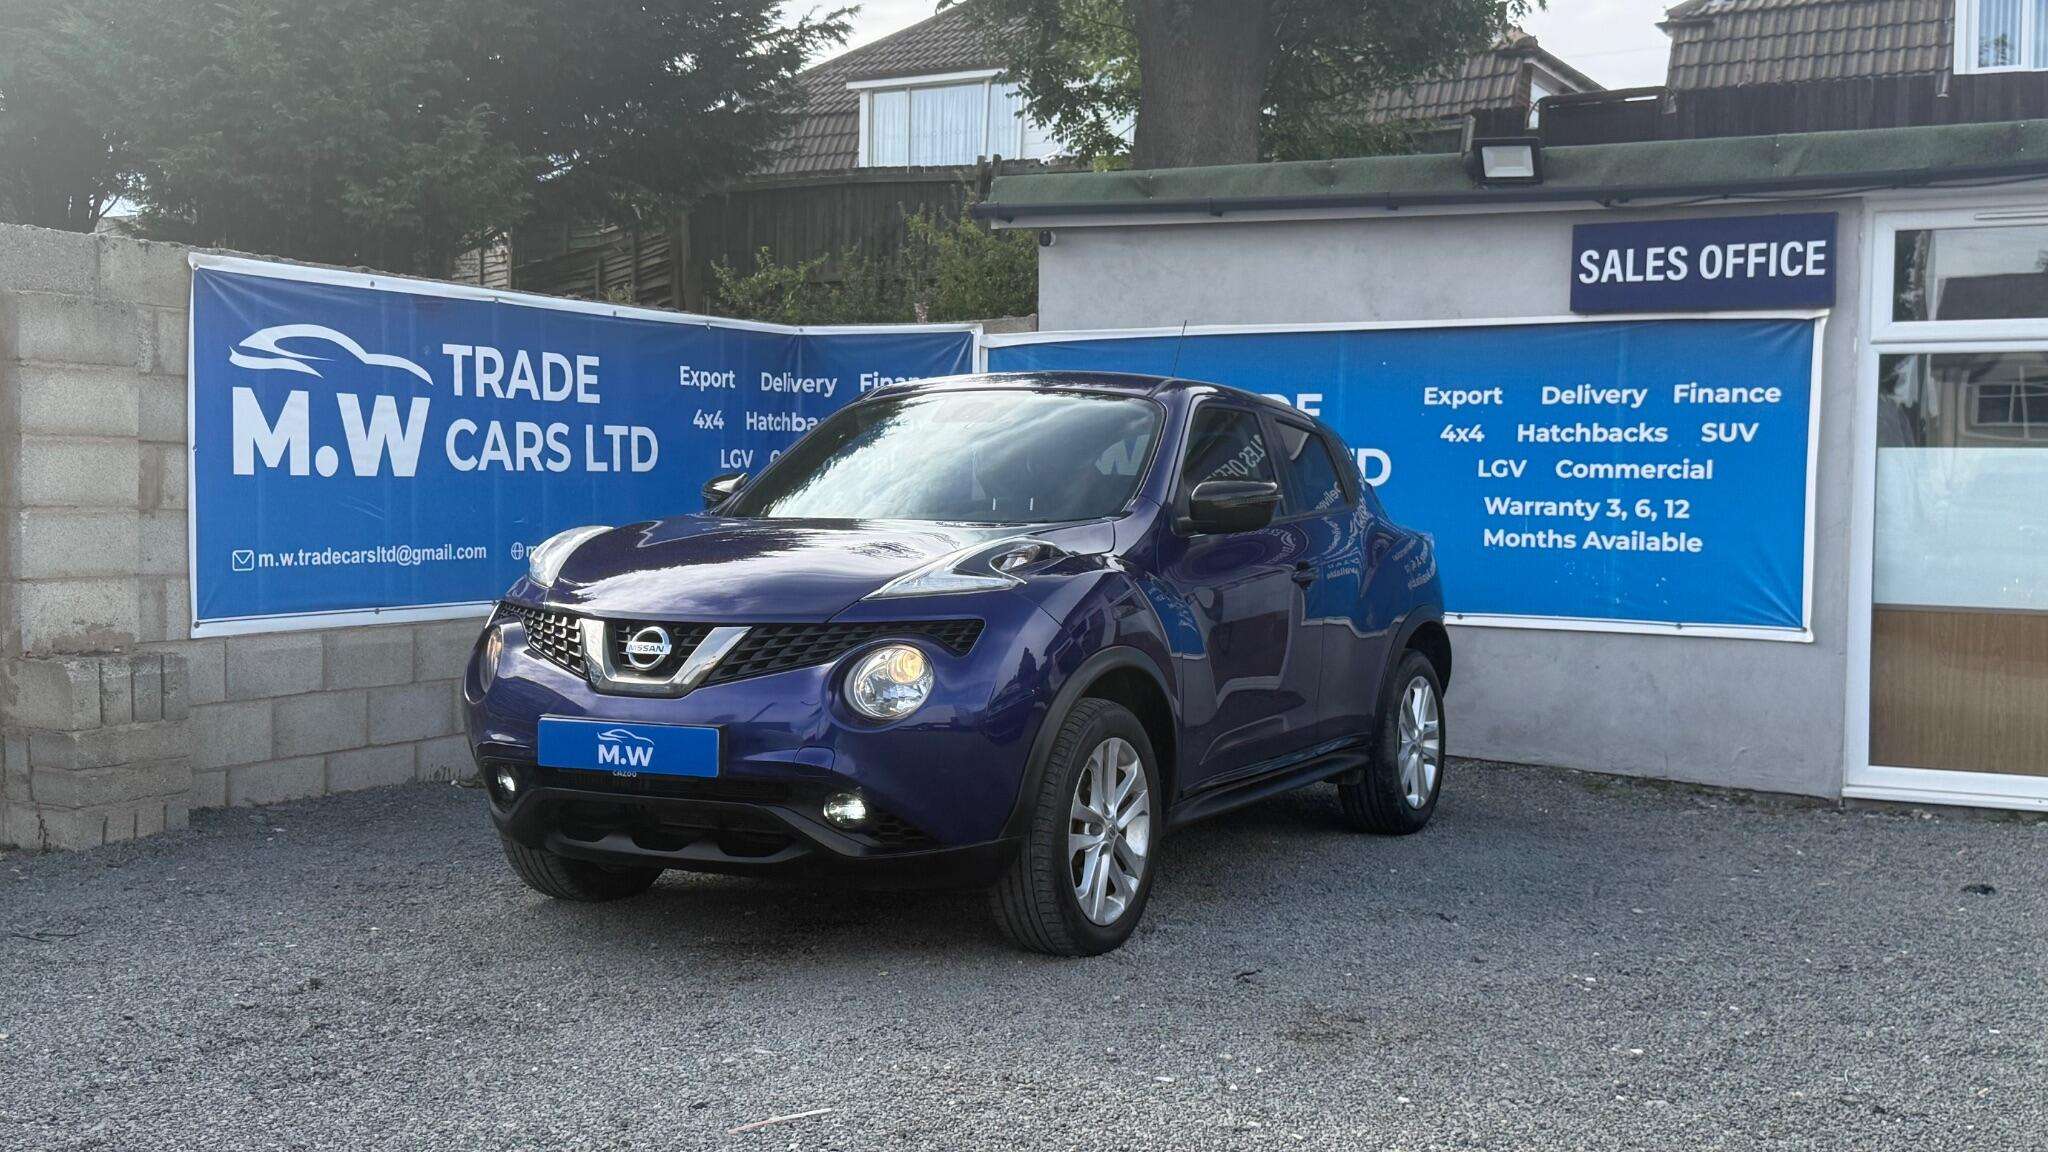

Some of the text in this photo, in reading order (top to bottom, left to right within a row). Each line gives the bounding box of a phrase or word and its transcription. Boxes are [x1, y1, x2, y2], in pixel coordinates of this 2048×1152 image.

[1578, 240, 1827, 284] SALES OFFICE
[442, 343, 601, 404] TRADE
[679, 365, 736, 392] Export
[760, 371, 838, 398] Delivery
[1423, 382, 1782, 409] Export Delivery Finance
[692, 408, 725, 430] 4x4
[232, 386, 431, 478] M.W
[1440, 422, 1760, 443] 4x4 Hatchbacks SUV
[445, 418, 659, 473] CARS LTD
[720, 448, 754, 469] LGV
[1477, 457, 1714, 480] LGV Commercial
[1483, 496, 1690, 522] Warranty 3, 6, 12
[1483, 528, 1703, 553] Months Available
[258, 543, 487, 568] m.w.tradecarsltd@gmail.com
[628, 643, 665, 653] NISSAN
[598, 743, 654, 767] M.W
